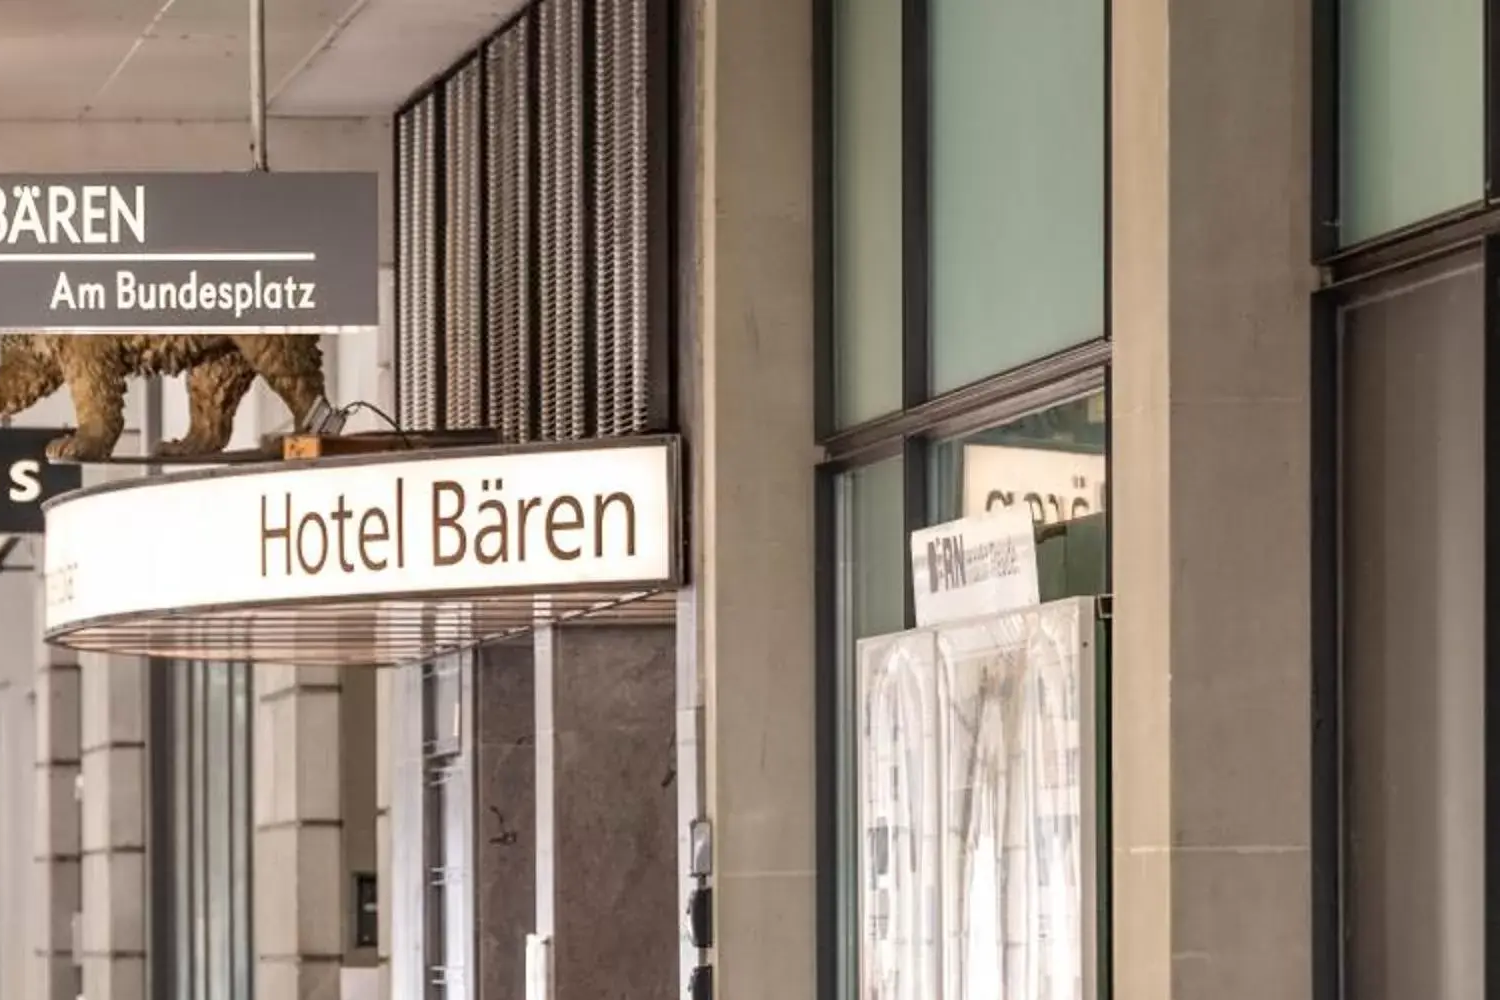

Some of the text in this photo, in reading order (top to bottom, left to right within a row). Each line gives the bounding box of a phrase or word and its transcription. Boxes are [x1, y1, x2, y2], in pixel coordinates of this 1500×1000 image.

[49, 270, 316, 318] Am Bundesplatz
[261, 477, 636, 577] Hotel Bären
